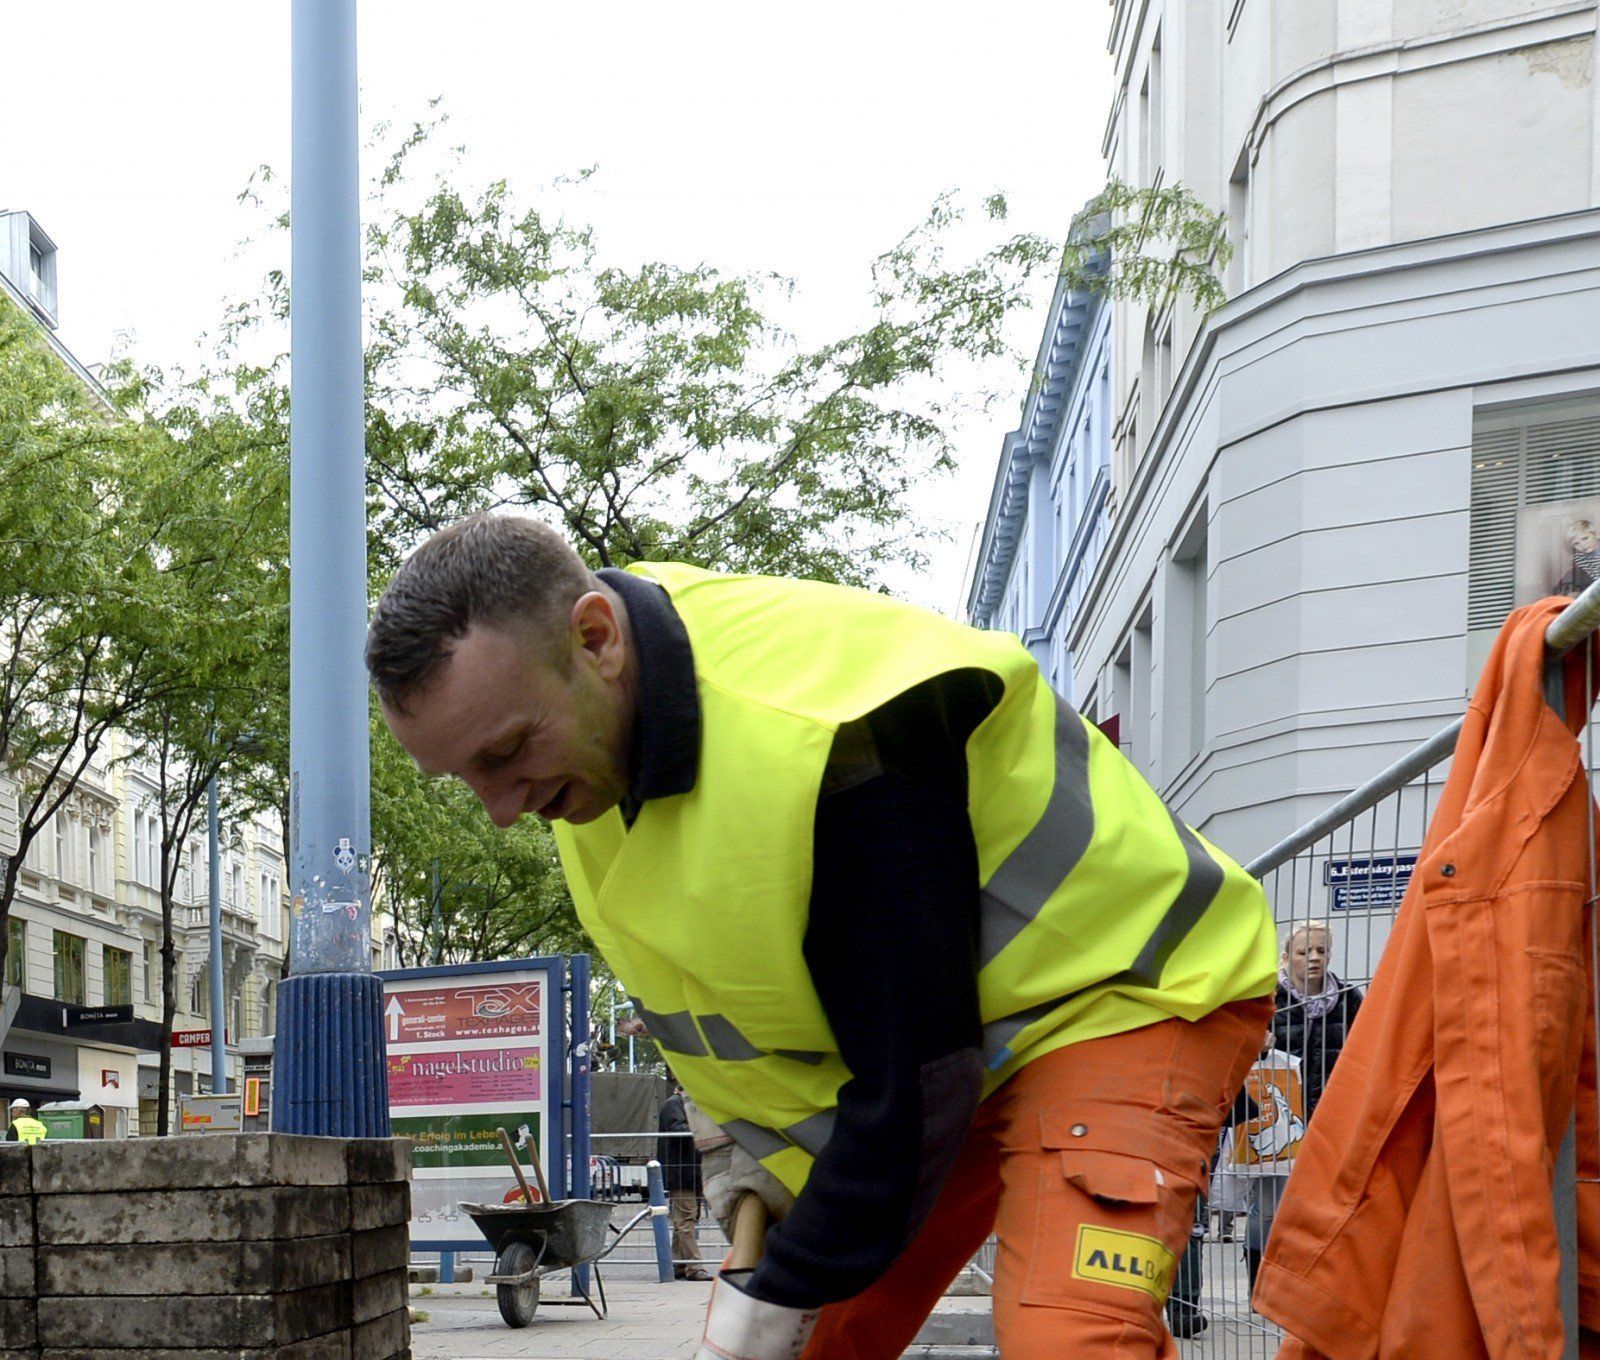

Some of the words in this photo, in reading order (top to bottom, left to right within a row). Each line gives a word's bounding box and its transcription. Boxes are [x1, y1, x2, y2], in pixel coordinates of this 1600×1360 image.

[1342, 863, 1415, 876] Esterházygass
[412, 1050, 524, 1081] nagelstudio
[419, 1130, 451, 1143] Erfolg
[453, 1130, 468, 1140] im
